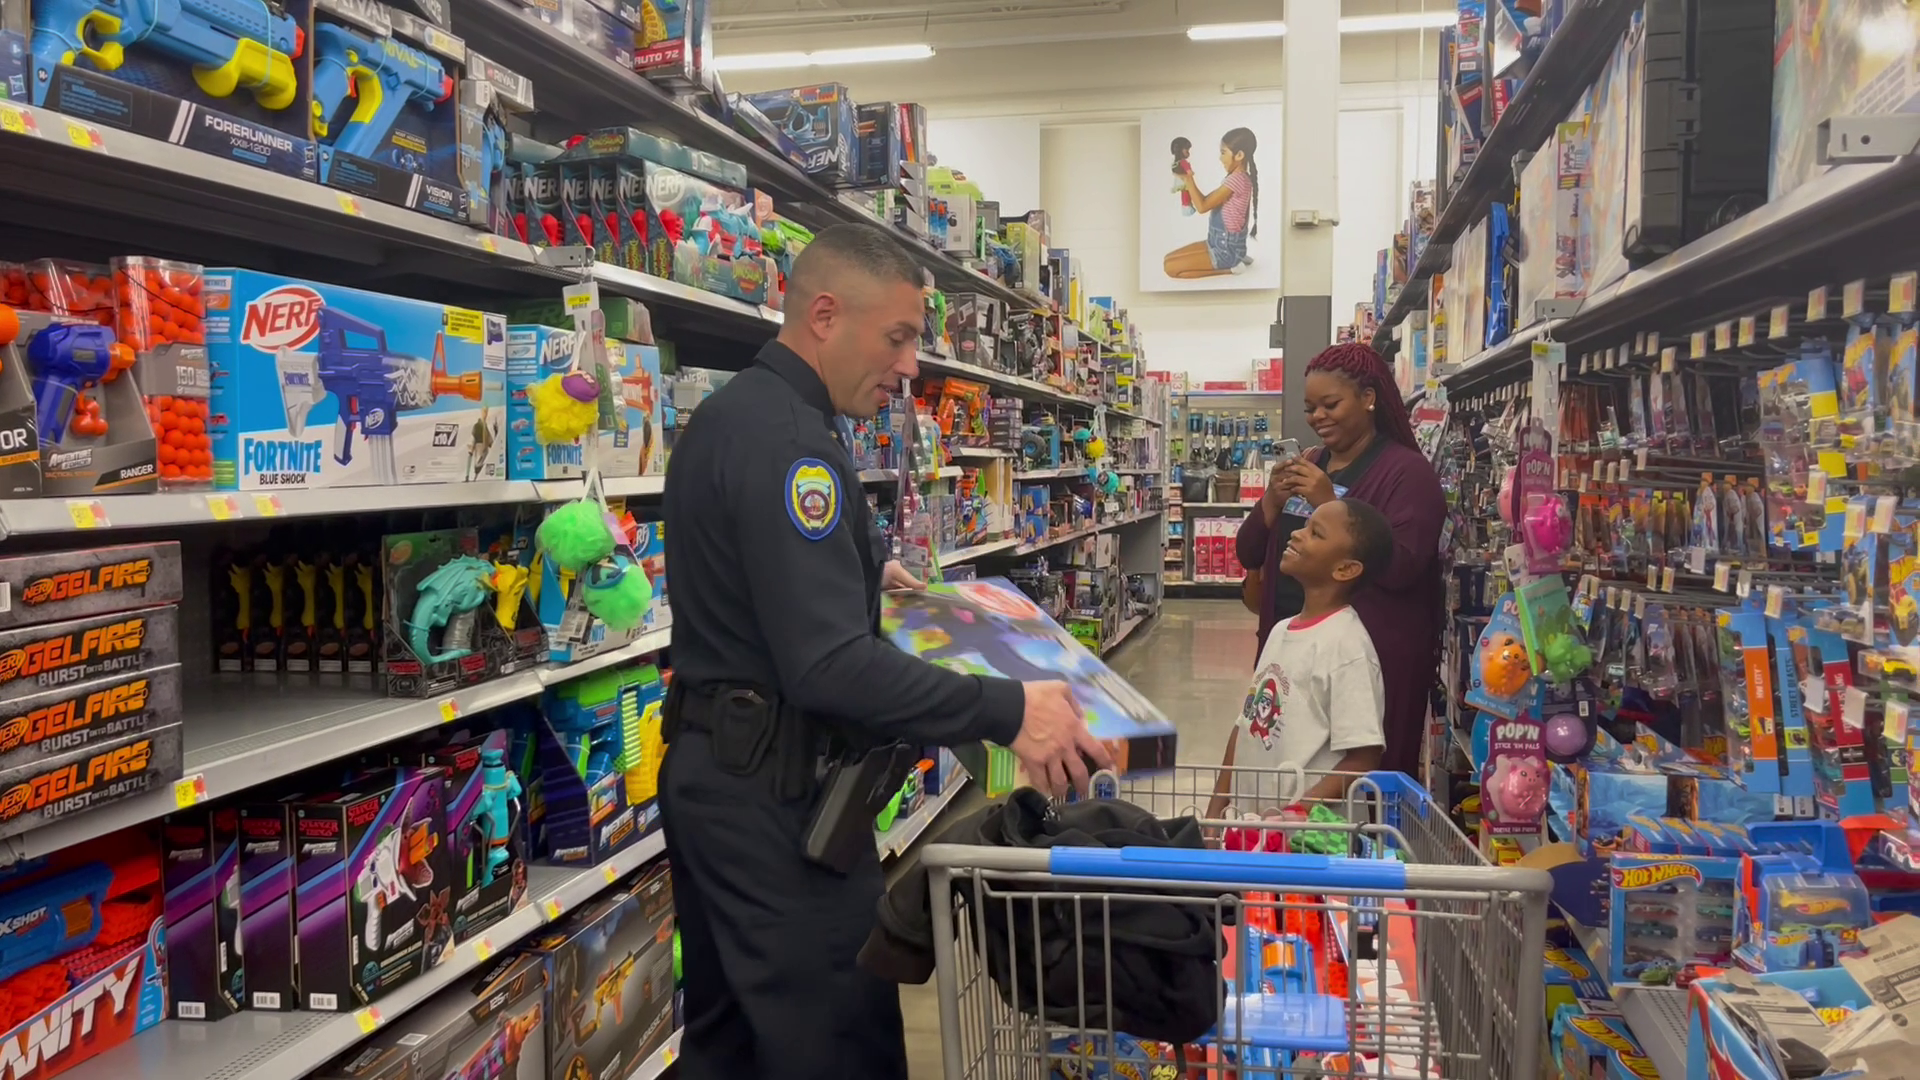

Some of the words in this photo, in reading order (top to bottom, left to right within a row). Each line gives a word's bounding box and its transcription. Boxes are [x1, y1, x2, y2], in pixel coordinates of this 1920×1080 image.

[634, 53, 662, 65] AUTO
[665, 50, 680, 60] 72
[493, 71, 516, 90] RIVAL
[205, 114, 293, 152] FORERUNNER
[425, 184, 453, 201] VISION
[524, 177, 558, 200] NER
[648, 172, 682, 197] NERF
[242, 297, 322, 341] NERF
[540, 332, 579, 365] NERF
[175, 366, 194, 385] 150
[365, 412, 383, 429] NERF
[49, 449, 92, 467] ADVENTURE
[244, 438, 322, 476] FORTNITE
[1526, 459, 1550, 476] POP'N
[120, 464, 154, 480] RANGER
[259, 474, 278, 486] BLUE
[280, 473, 307, 484] SHOCK
[50, 559, 151, 600] GELFIRE
[21, 618, 145, 676] GELFIRE
[39, 664, 87, 687] BURST
[103, 653, 146, 672] BATTLE
[24, 680, 148, 744] GELFIRE
[1790, 690, 1800, 718] STREET
[41, 729, 89, 752] BURST
[107, 713, 149, 735] BATTLE
[1496, 722, 1540, 740] POP'N
[26, 739, 151, 809] GELFIRE
[44, 792, 91, 818] BURST
[109, 774, 151, 795] BATTLE
[347, 796, 379, 821] STRANGER
[300, 819, 338, 832] STRANGER
[1623, 868, 1651, 888] HOT
[1651, 863, 1697, 884] WHEELS
